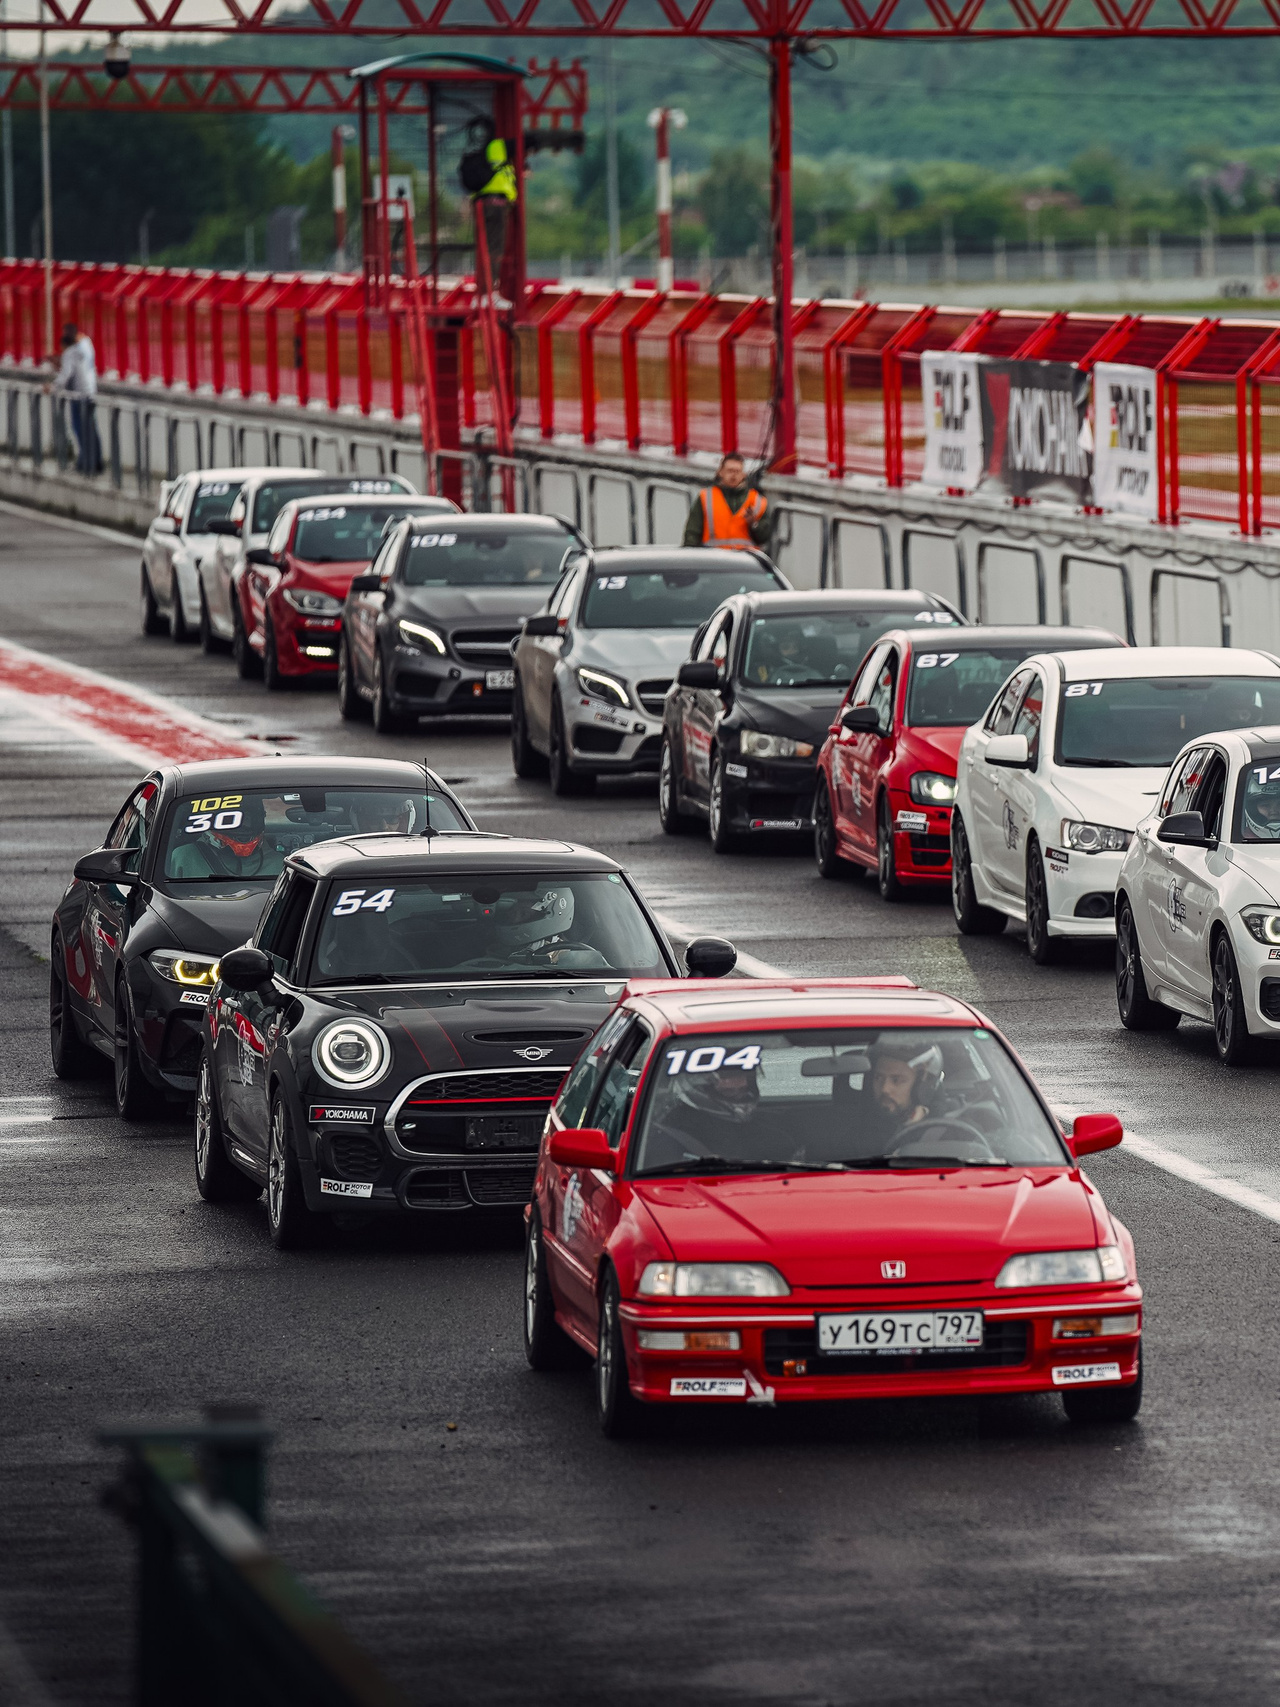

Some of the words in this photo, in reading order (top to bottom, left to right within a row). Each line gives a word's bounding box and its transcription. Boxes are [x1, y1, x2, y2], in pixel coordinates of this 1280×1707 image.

[597, 575, 628, 591] 13
[1064, 682, 1104, 698] 81
[191, 795, 243, 813] 102
[185, 811, 243, 833] 30
[332, 889, 396, 916] 54
[667, 1046, 761, 1075] 104
[325, 1109, 368, 1120] YOKOHAMA
[327, 1182, 350, 1193] ROLF
[937, 1315, 975, 1336] 797
[1063, 1368, 1095, 1378] ROLF
[682, 1381, 717, 1392] ROLF
